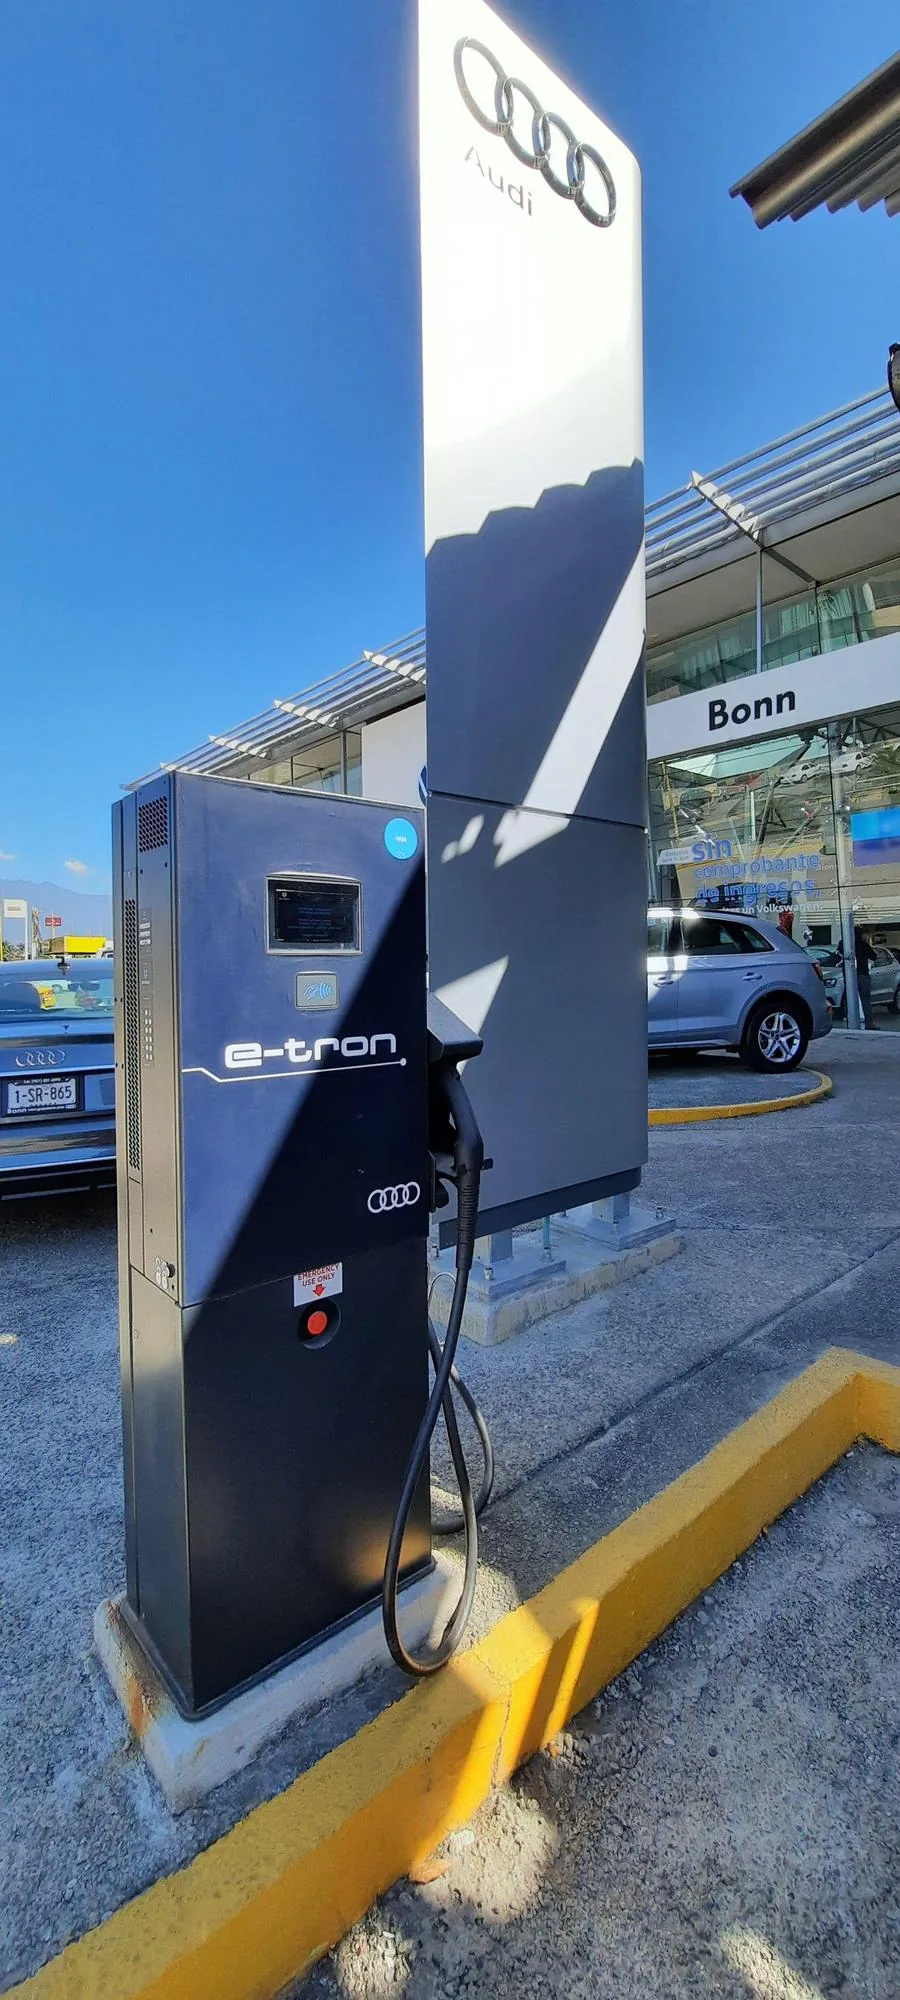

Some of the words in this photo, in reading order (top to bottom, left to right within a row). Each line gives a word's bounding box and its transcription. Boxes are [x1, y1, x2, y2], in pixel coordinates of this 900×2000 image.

[465, 146, 532, 216] Audi
[708, 690, 796, 731] Bonn
[691, 834, 732, 861] sin
[694, 853, 821, 881] comprobante
[697, 884, 720, 903] de
[224, 1032, 397, 1069] e-tron
[15, 1085, 72, 1103] 1-SR-865
[297, 1264, 340, 1281] EMERGENCY
[302, 1277, 316, 1287] USE
[317, 1272, 336, 1283] ONLY
